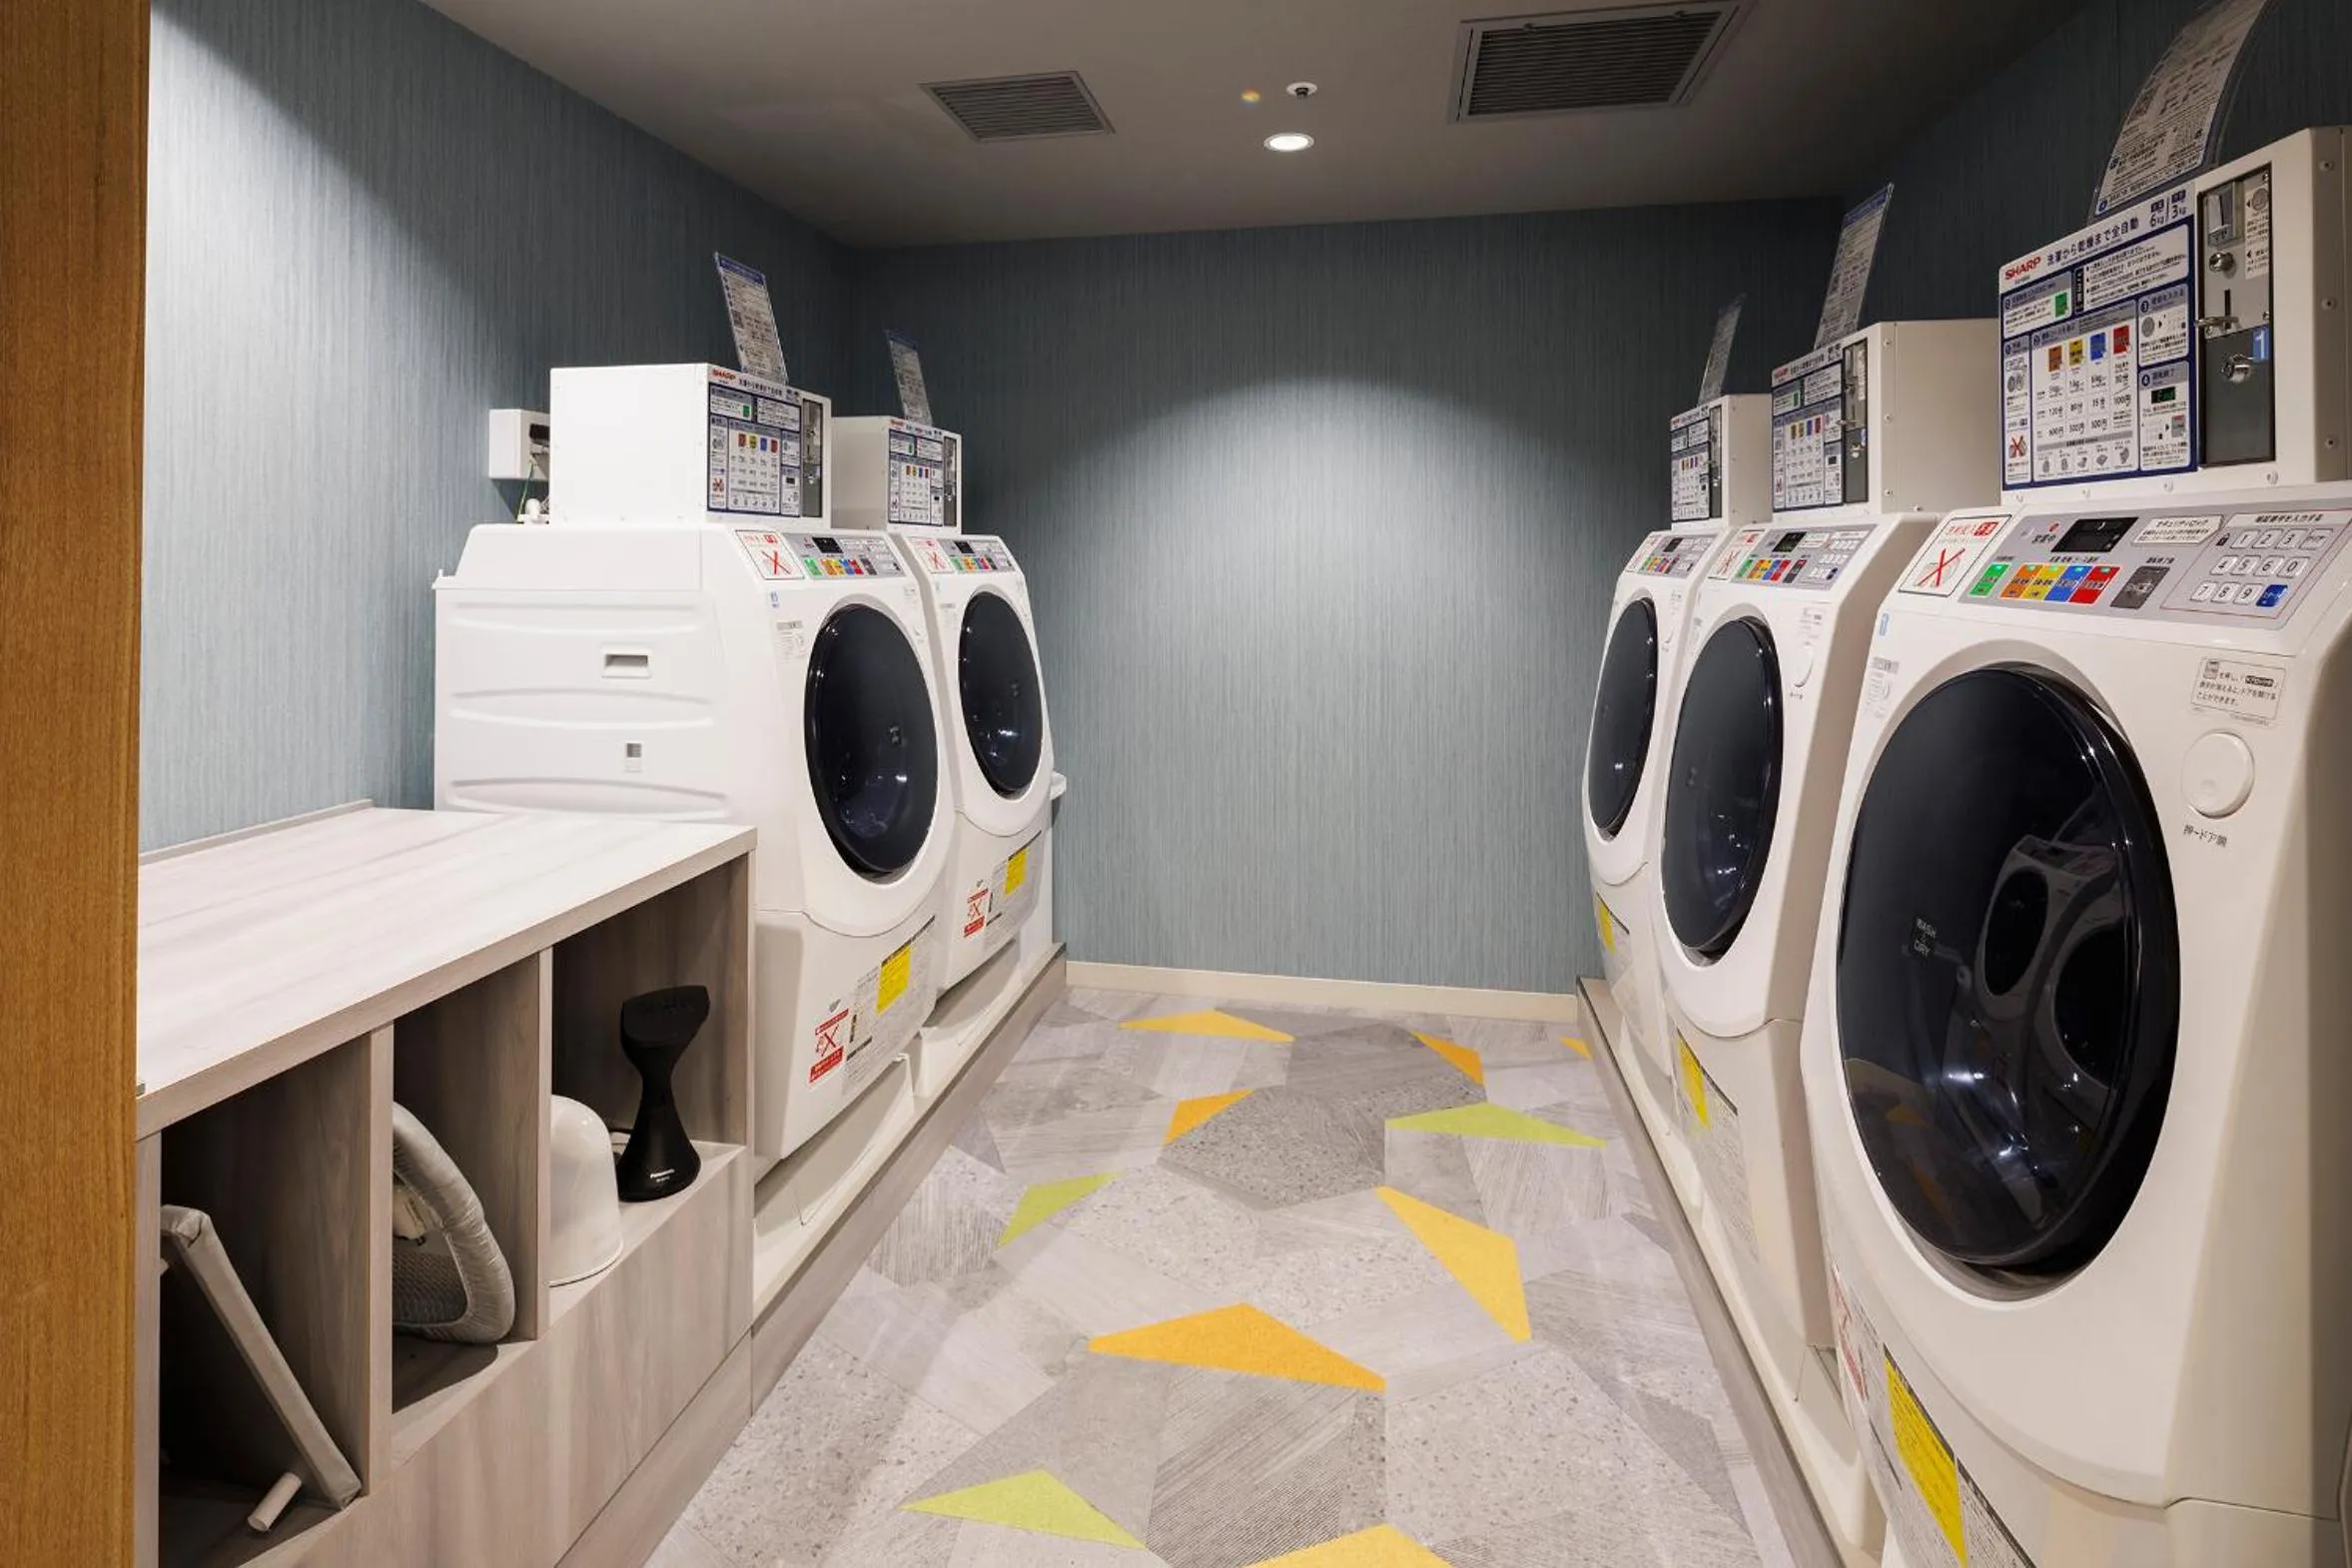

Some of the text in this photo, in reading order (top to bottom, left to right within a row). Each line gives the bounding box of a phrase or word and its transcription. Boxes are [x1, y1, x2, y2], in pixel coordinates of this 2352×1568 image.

[2004, 256, 2041, 281] SHARP
[2239, 533, 2293, 544] 1 2 3
[2218, 560, 2297, 571] 4 5 6 0
[2199, 586, 2248, 599] 7 8 9
